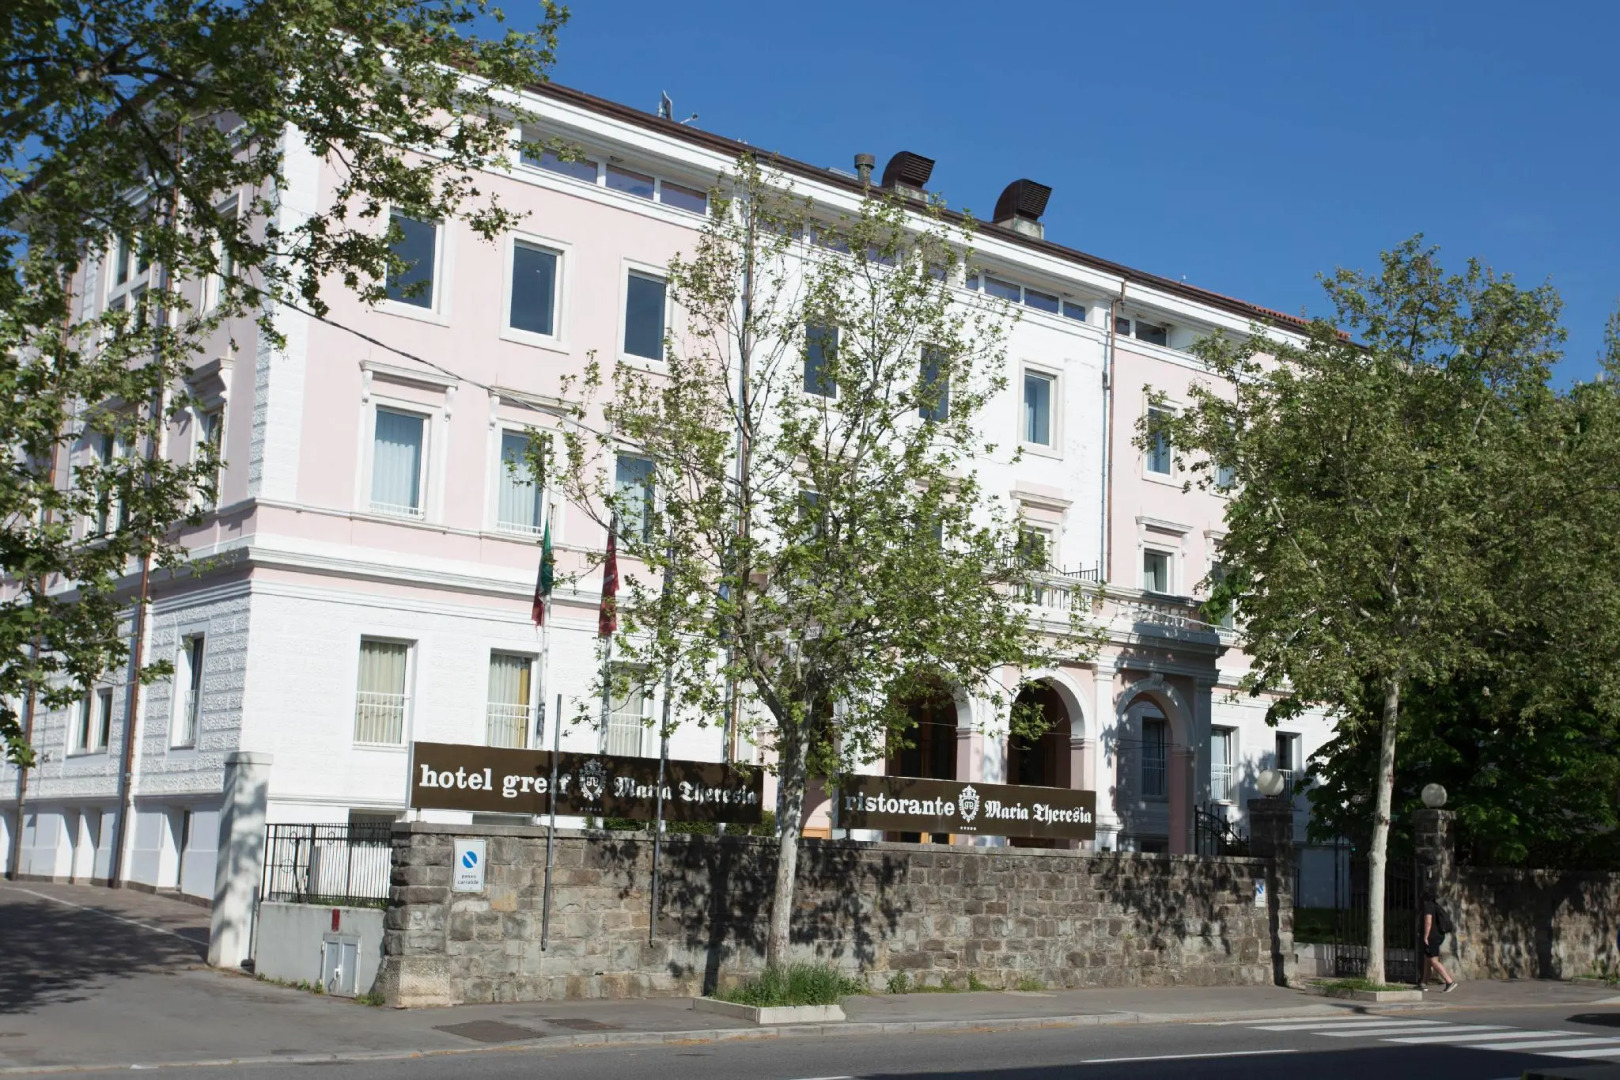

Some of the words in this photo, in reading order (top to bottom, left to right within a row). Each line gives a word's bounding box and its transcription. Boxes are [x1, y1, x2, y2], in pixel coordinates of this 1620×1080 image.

[419, 764, 493, 791] hotel
[614, 776, 672, 800] Maria
[678, 780, 758, 805] Theresia
[844, 791, 955, 816] ristorante
[984, 799, 1029, 820] Maria
[1033, 803, 1092, 825] Theresia
